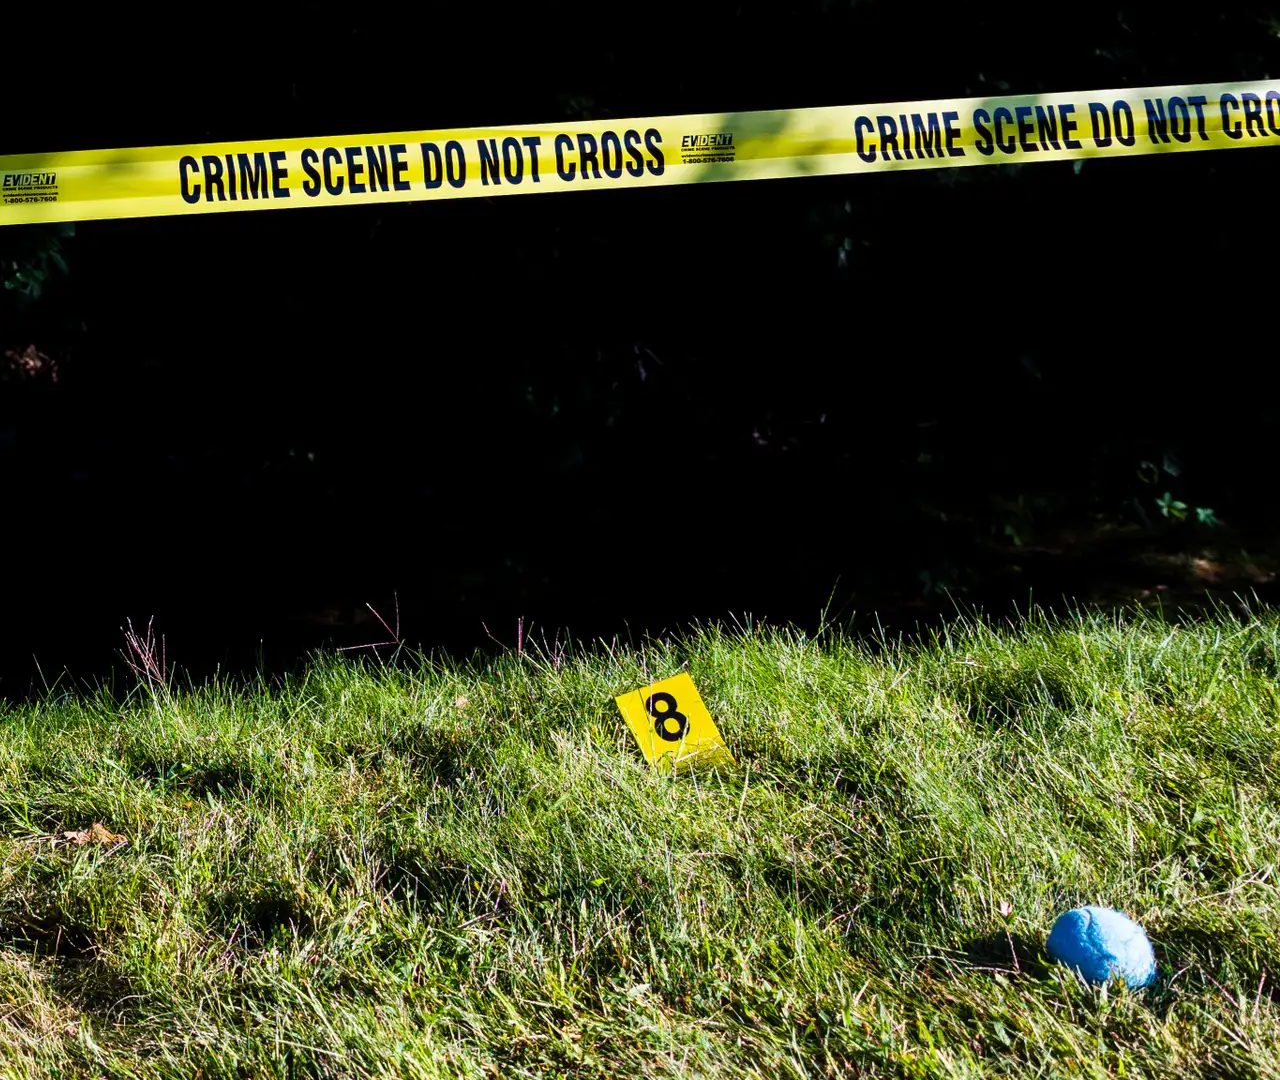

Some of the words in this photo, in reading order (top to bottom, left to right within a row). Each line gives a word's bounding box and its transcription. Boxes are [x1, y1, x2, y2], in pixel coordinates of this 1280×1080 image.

[681, 133, 733, 147] EVIDENT
[854, 111, 966, 163] CRIME
[972, 103, 1083, 156] SCENE
[1088, 99, 1136, 148] DO
[1143, 95, 1210, 145] NOT
[3, 172, 57, 187] EVIDENT
[179, 150, 291, 204] CRIME
[300, 143, 411, 198] SCENE
[420, 140, 467, 190] DO
[477, 136, 542, 186] NOT
[554, 128, 665, 182] CROSS
[645, 691, 690, 742] 8
